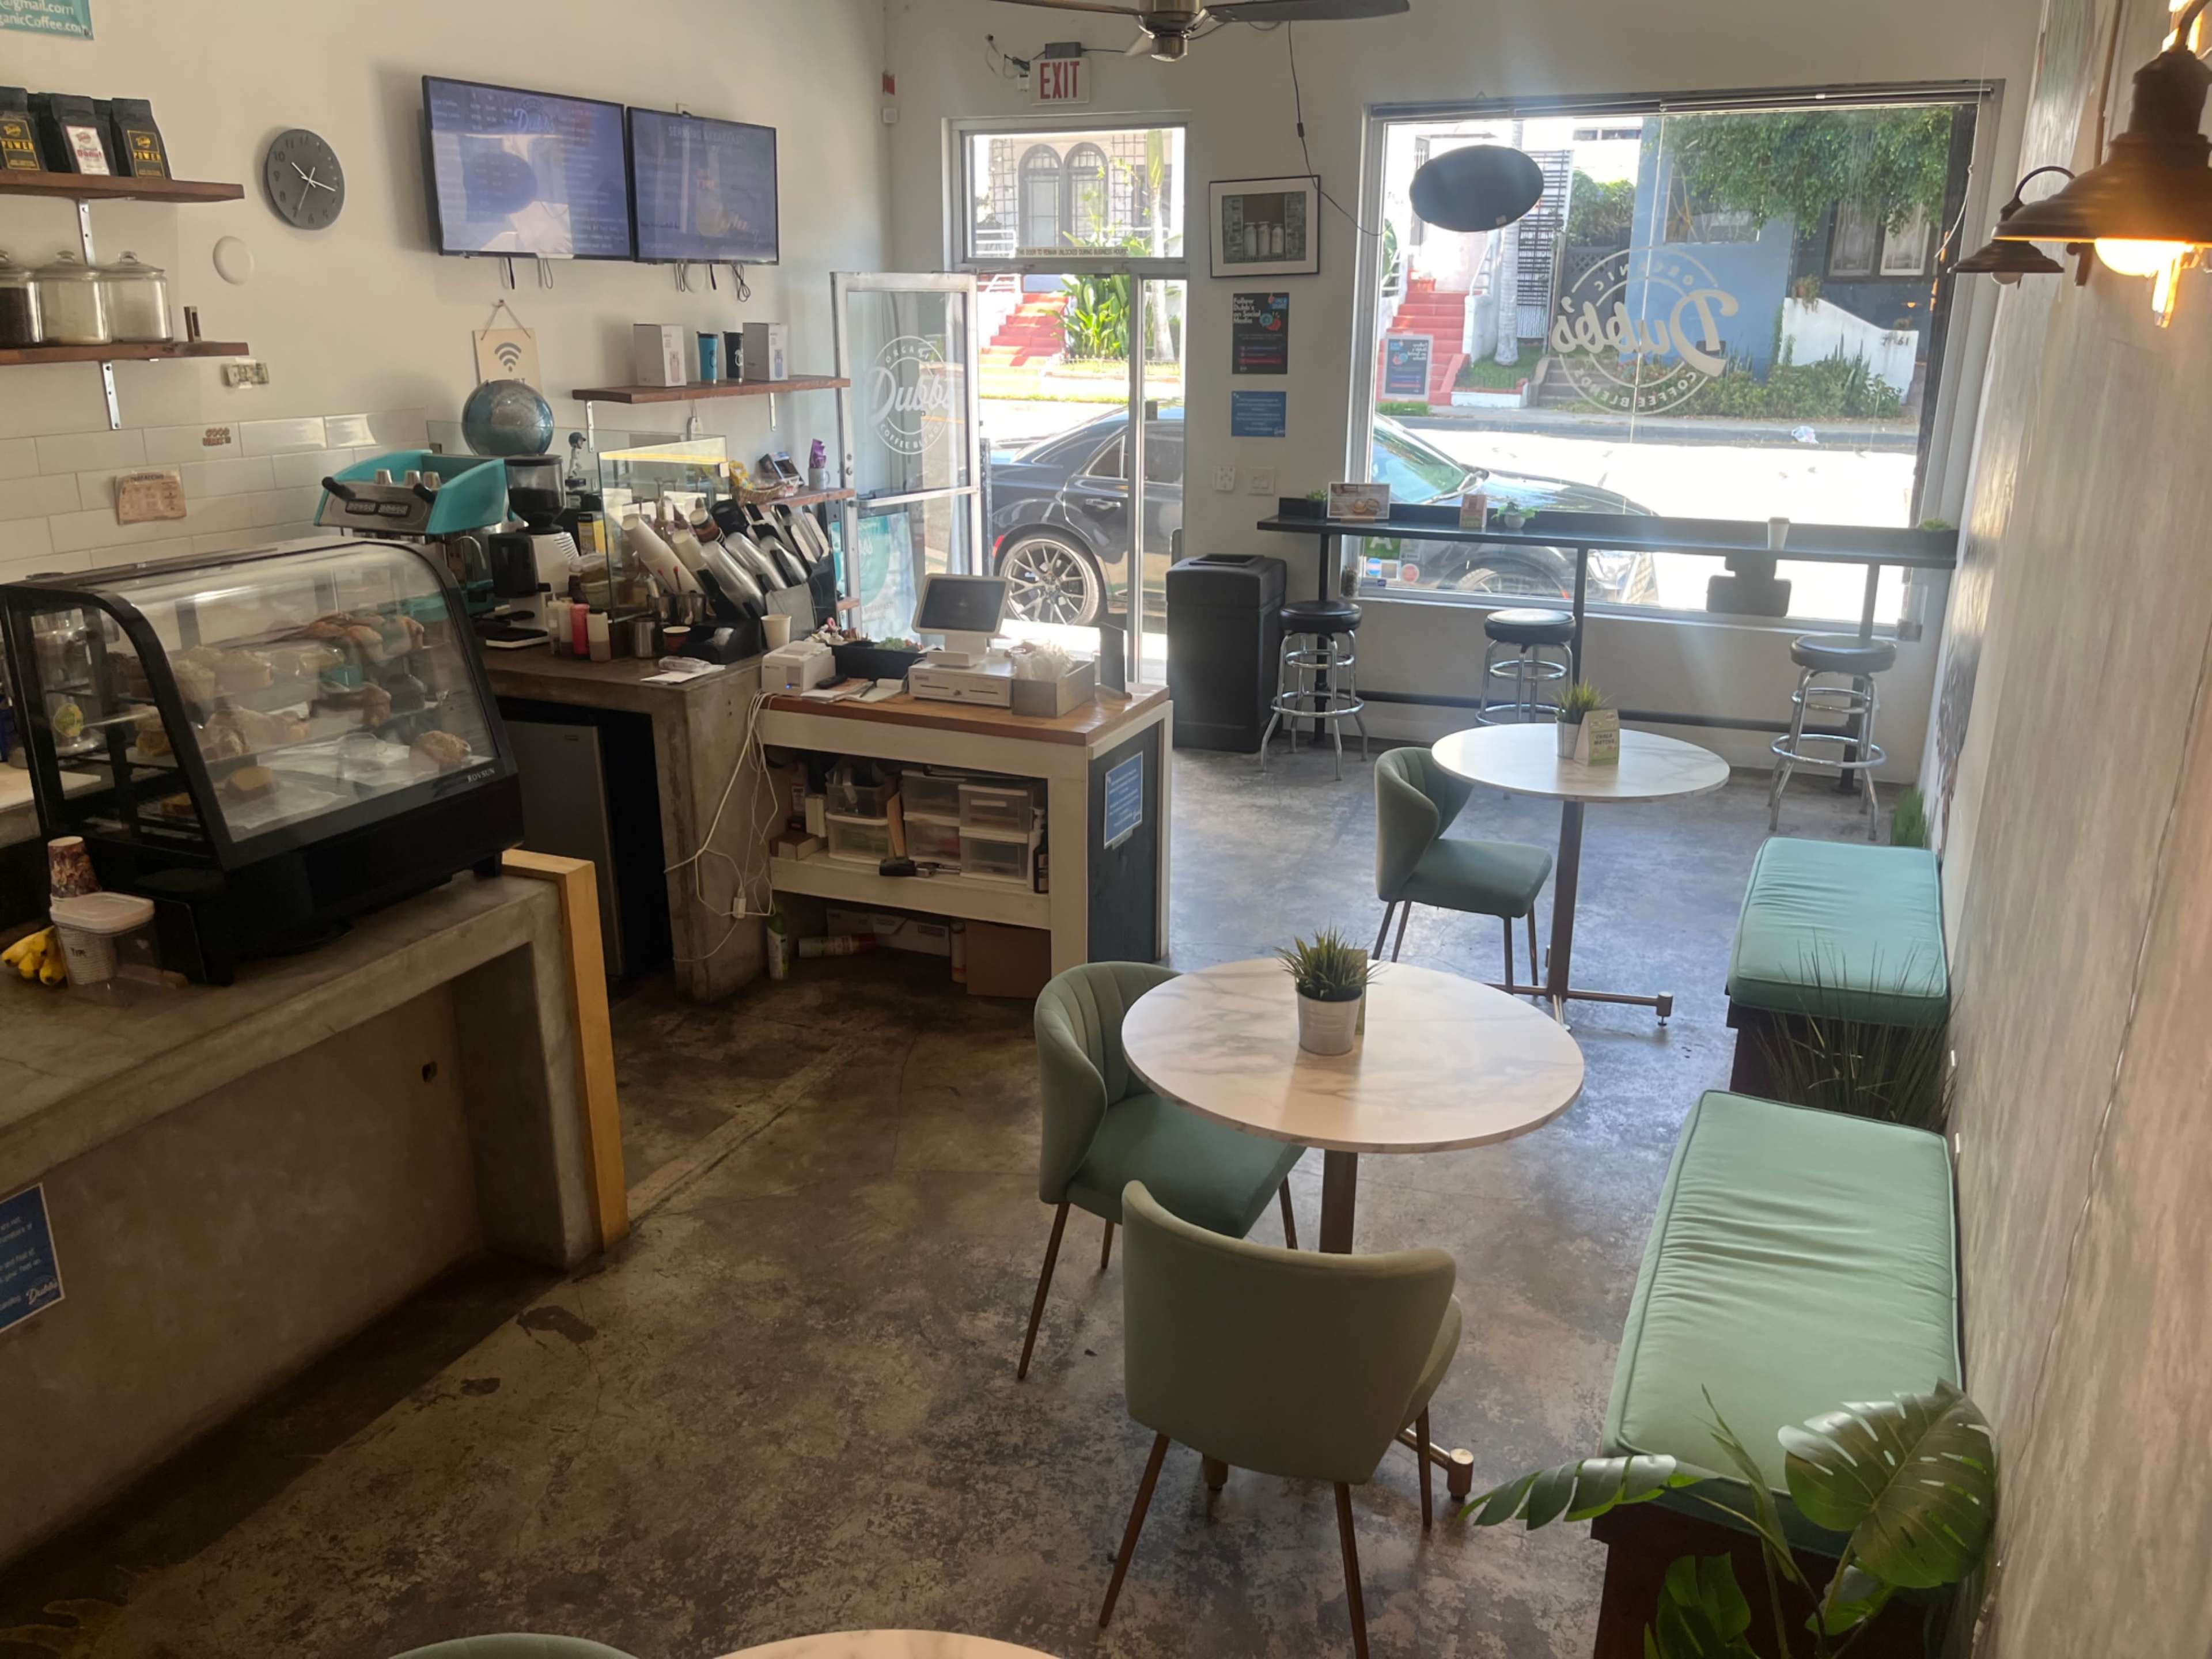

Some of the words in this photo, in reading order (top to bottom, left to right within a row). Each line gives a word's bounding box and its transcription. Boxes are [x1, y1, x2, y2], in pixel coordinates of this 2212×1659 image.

[1040, 61, 1080, 99] EXIT
[1, 140, 33, 150] POWER
[133, 151, 161, 161] POWER
[1233, 297, 1255, 305] Follow
[1243, 310, 1261, 318] Social
[880, 422, 910, 444] COFFEE
[467, 767, 495, 783] ROVSUN
